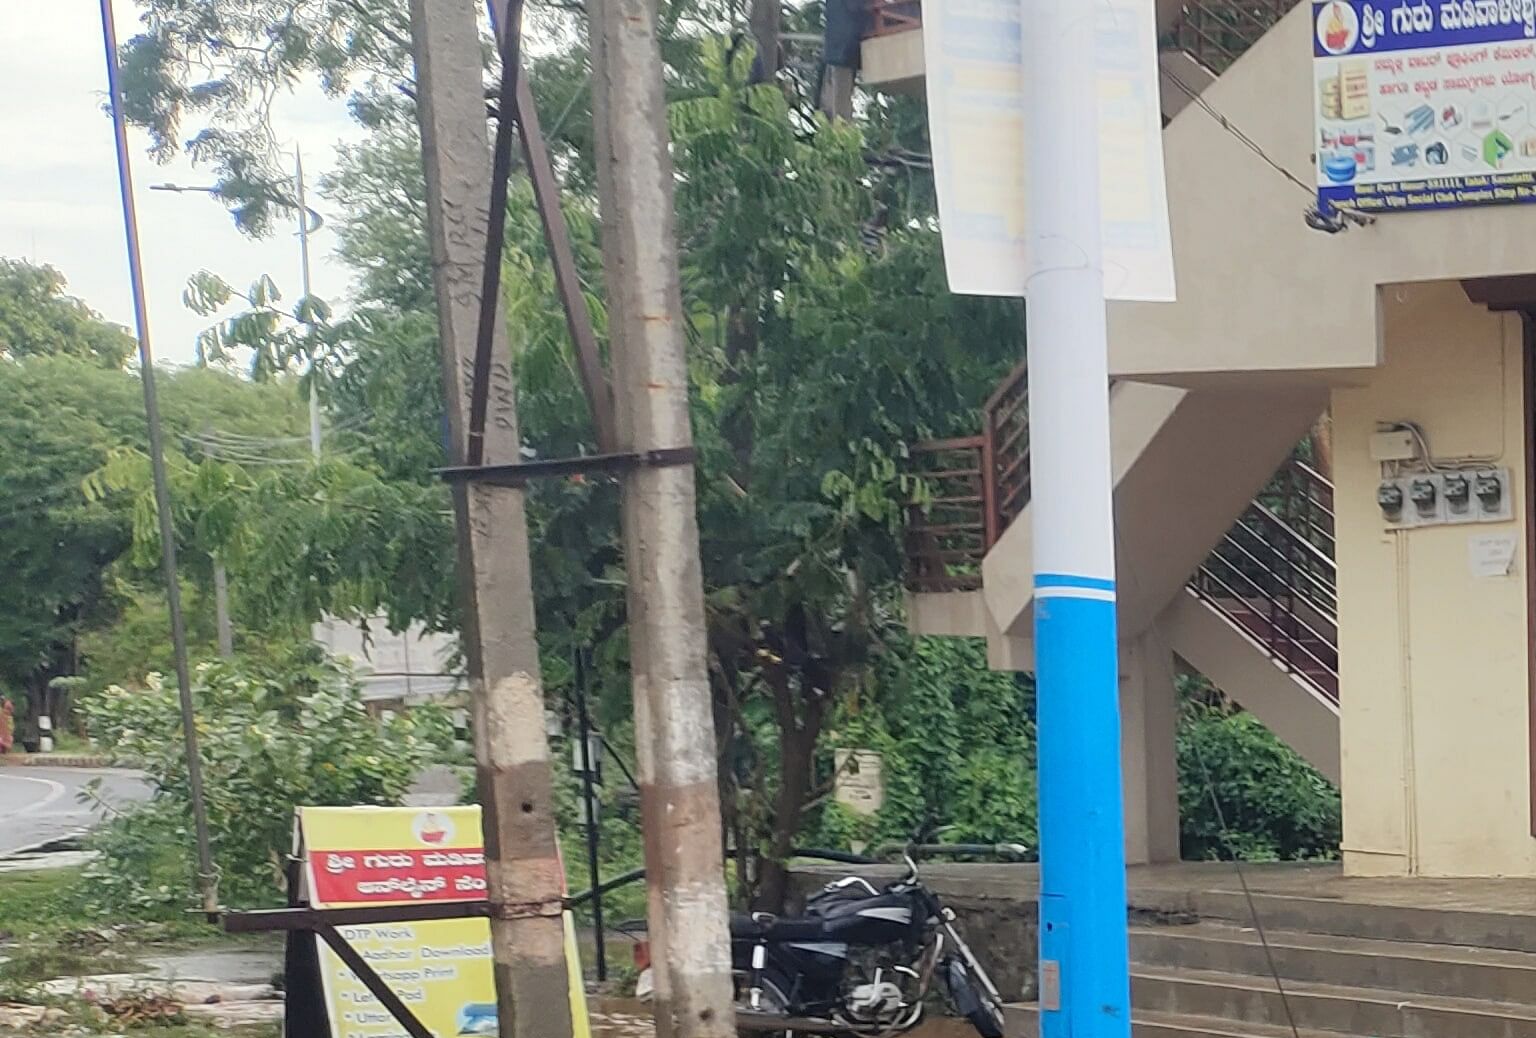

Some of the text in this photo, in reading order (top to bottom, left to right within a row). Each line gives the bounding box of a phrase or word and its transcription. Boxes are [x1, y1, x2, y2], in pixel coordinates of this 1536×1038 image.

[1361, 3, 1385, 48] ಶ್ರೀ
[1391, 0, 1433, 34] ಗುರು
[326, 853, 356, 873] ಶ್ರೀ
[363, 853, 414, 868] ಗುರು
[344, 928, 412, 940] DTP Work
[421, 946, 490, 958] Download
[424, 968, 454, 979] Print
